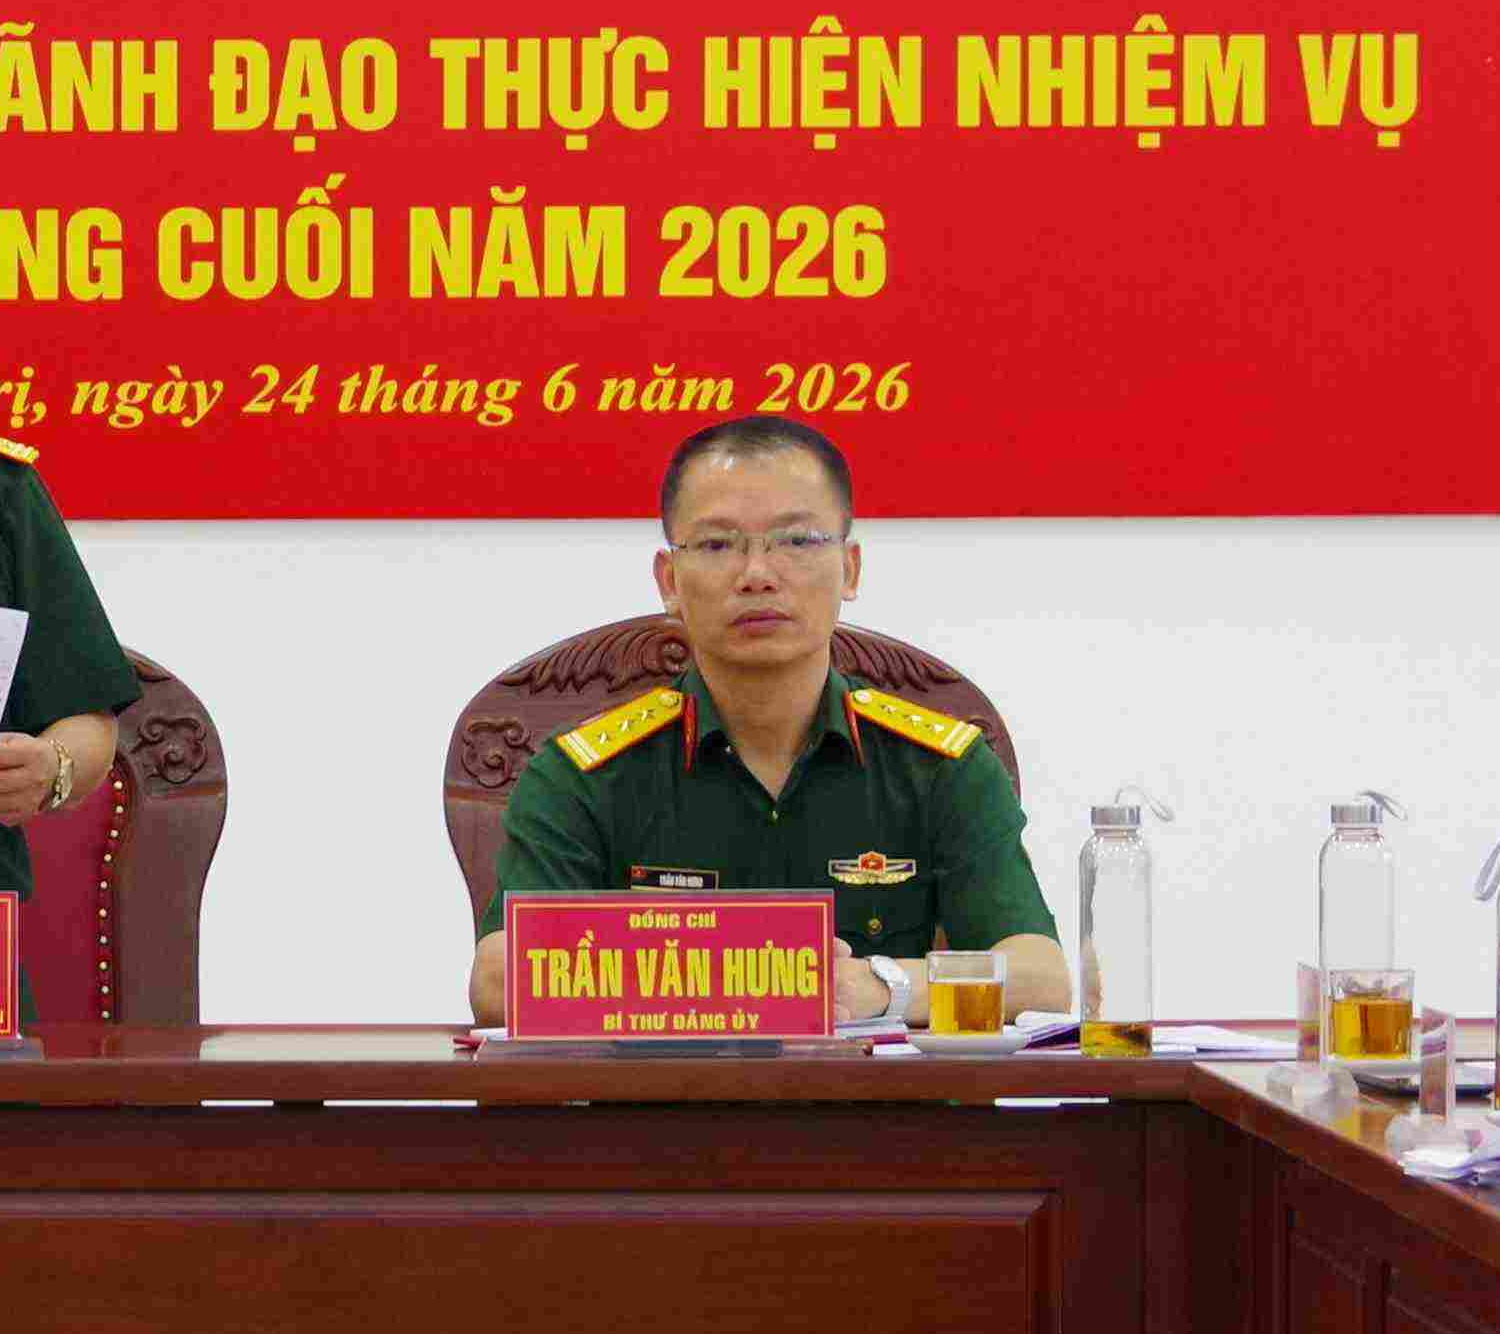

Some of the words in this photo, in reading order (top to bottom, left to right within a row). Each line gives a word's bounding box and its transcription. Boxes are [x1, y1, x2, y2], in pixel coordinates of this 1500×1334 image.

[208, 37, 398, 153] ĐẠO
[429, 26, 670, 152] THỰC
[703, 15, 923, 151] HIỆN
[956, 13, 1266, 150] NHIỆM
[1298, 32, 1419, 149] VỤ
[157, 172, 374, 302] CUỐI
[408, 185, 626, 300] NĂM
[658, 203, 888, 300] 2026
[70, 364, 224, 430] ngày
[242, 364, 319, 415] 24
[338, 363, 522, 428] tháng
[542, 363, 579, 413] 6
[597, 362, 735, 413] năm
[756, 361, 913, 413] 2026
[527, 929, 624, 998] TRẦN
[636, 939, 711, 998] VĂN
[723, 940, 819, 998] HƯNG
